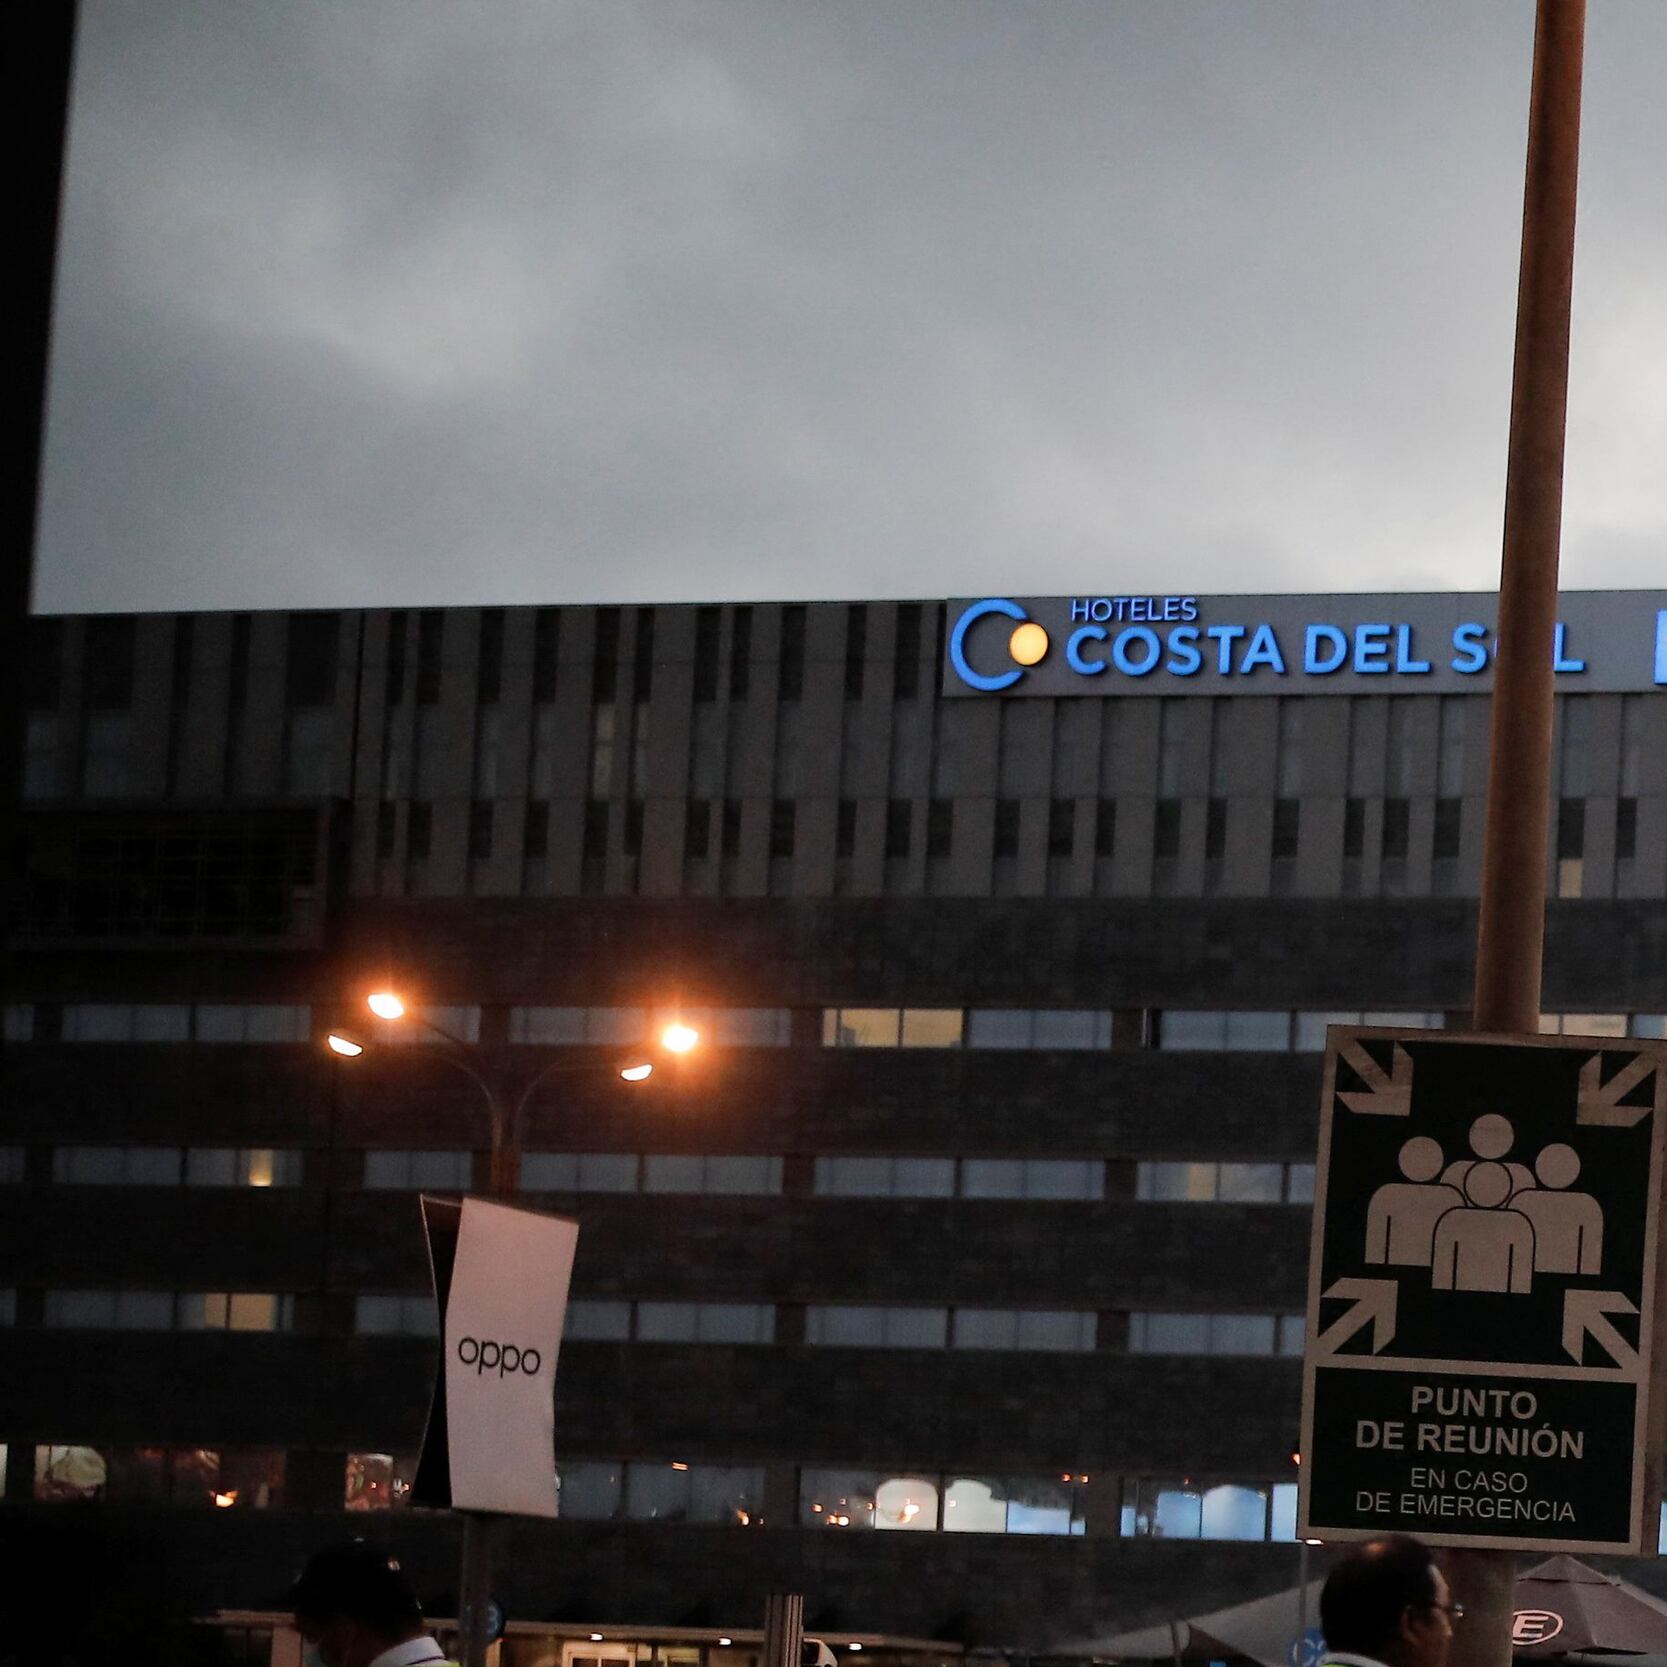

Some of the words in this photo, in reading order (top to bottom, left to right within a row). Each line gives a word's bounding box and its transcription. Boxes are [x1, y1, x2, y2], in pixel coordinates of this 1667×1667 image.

[1071, 597, 1198, 622] HOTELES
[1065, 624, 1287, 676] COSTA
[1303, 623, 1432, 675] DEL
[1450, 622, 1585, 674] SL
[458, 1337, 541, 1379] oppo
[1411, 1385, 1538, 1420] PUNTO
[1355, 1420, 1405, 1451] DE
[1417, 1422, 1585, 1460] REUNIÓN
[1411, 1468, 1446, 1490] EN
[1454, 1470, 1529, 1493] CASO
[1356, 1491, 1392, 1513] DE
[1400, 1493, 1576, 1523] EMERGENCIA
